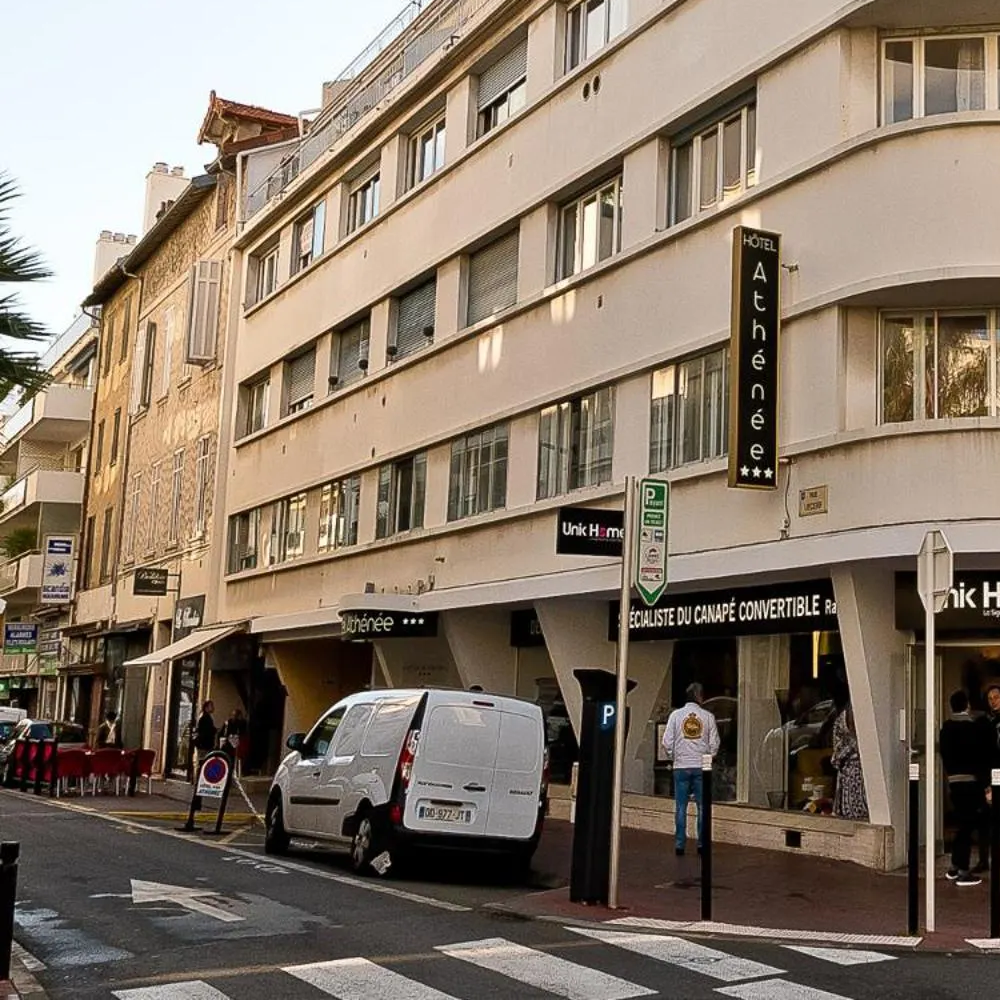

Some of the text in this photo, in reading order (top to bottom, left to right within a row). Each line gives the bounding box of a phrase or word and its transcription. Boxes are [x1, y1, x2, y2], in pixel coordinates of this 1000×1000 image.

[743, 233, 777, 252] HÔTEL
[750, 260, 768, 461] Athénée
[943, 581, 977, 609] nik
[618, 606, 675, 631] ÉCIALISTE
[677, 606, 692, 627] DU
[694, 597, 736, 625] CANAPÉ
[738, 594, 821, 622] CONVERTIBLE
[603, 704, 615, 725] P
